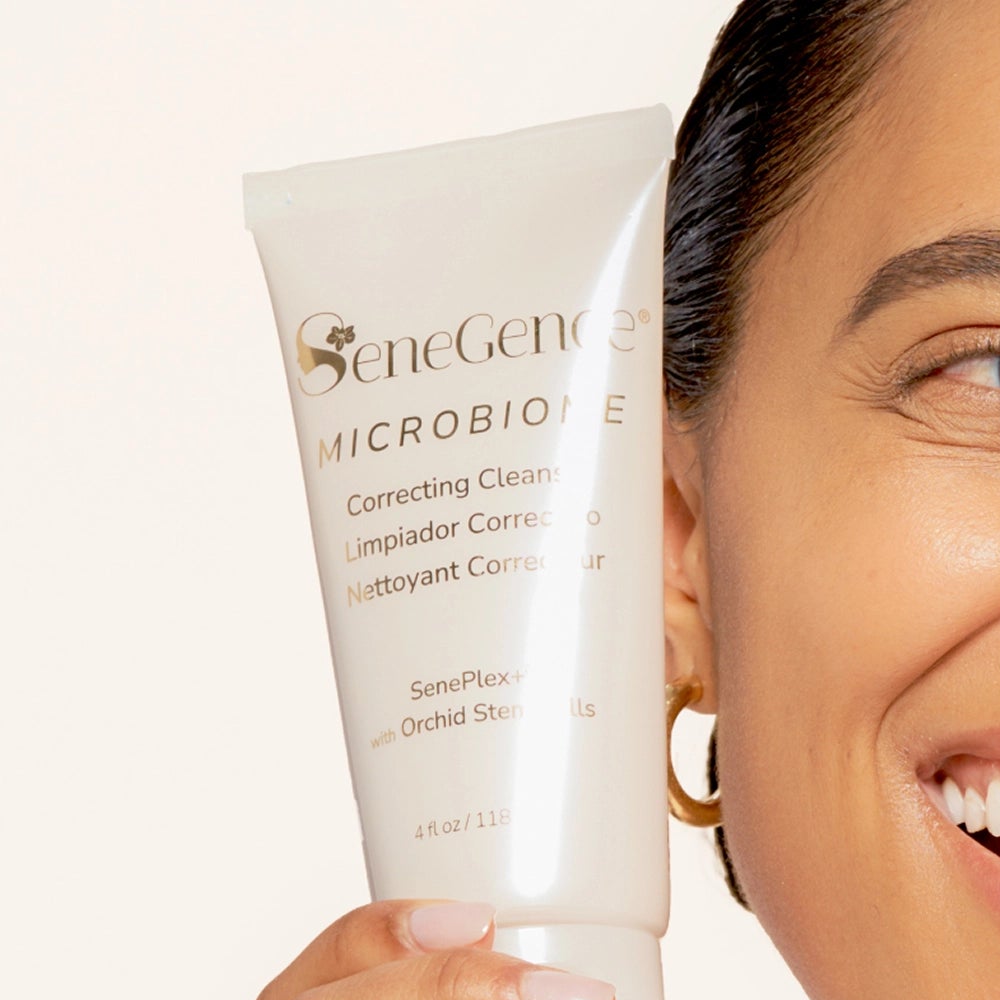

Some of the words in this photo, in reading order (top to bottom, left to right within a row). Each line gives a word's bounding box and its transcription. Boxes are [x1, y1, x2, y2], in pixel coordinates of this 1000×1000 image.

[347, 476, 470, 517] Correcting
[478, 466, 560, 490] Cleans
[345, 520, 460, 563] Limpiador
[467, 510, 601, 535] Correco
[346, 561, 460, 608] Nettoyant
[370, 729, 396, 750] with
[400, 706, 466, 738] Orchid
[414, 825, 424, 841] 4
[428, 820, 440, 838] fl
[442, 818, 461, 835] oz
[477, 808, 513, 829] 118
